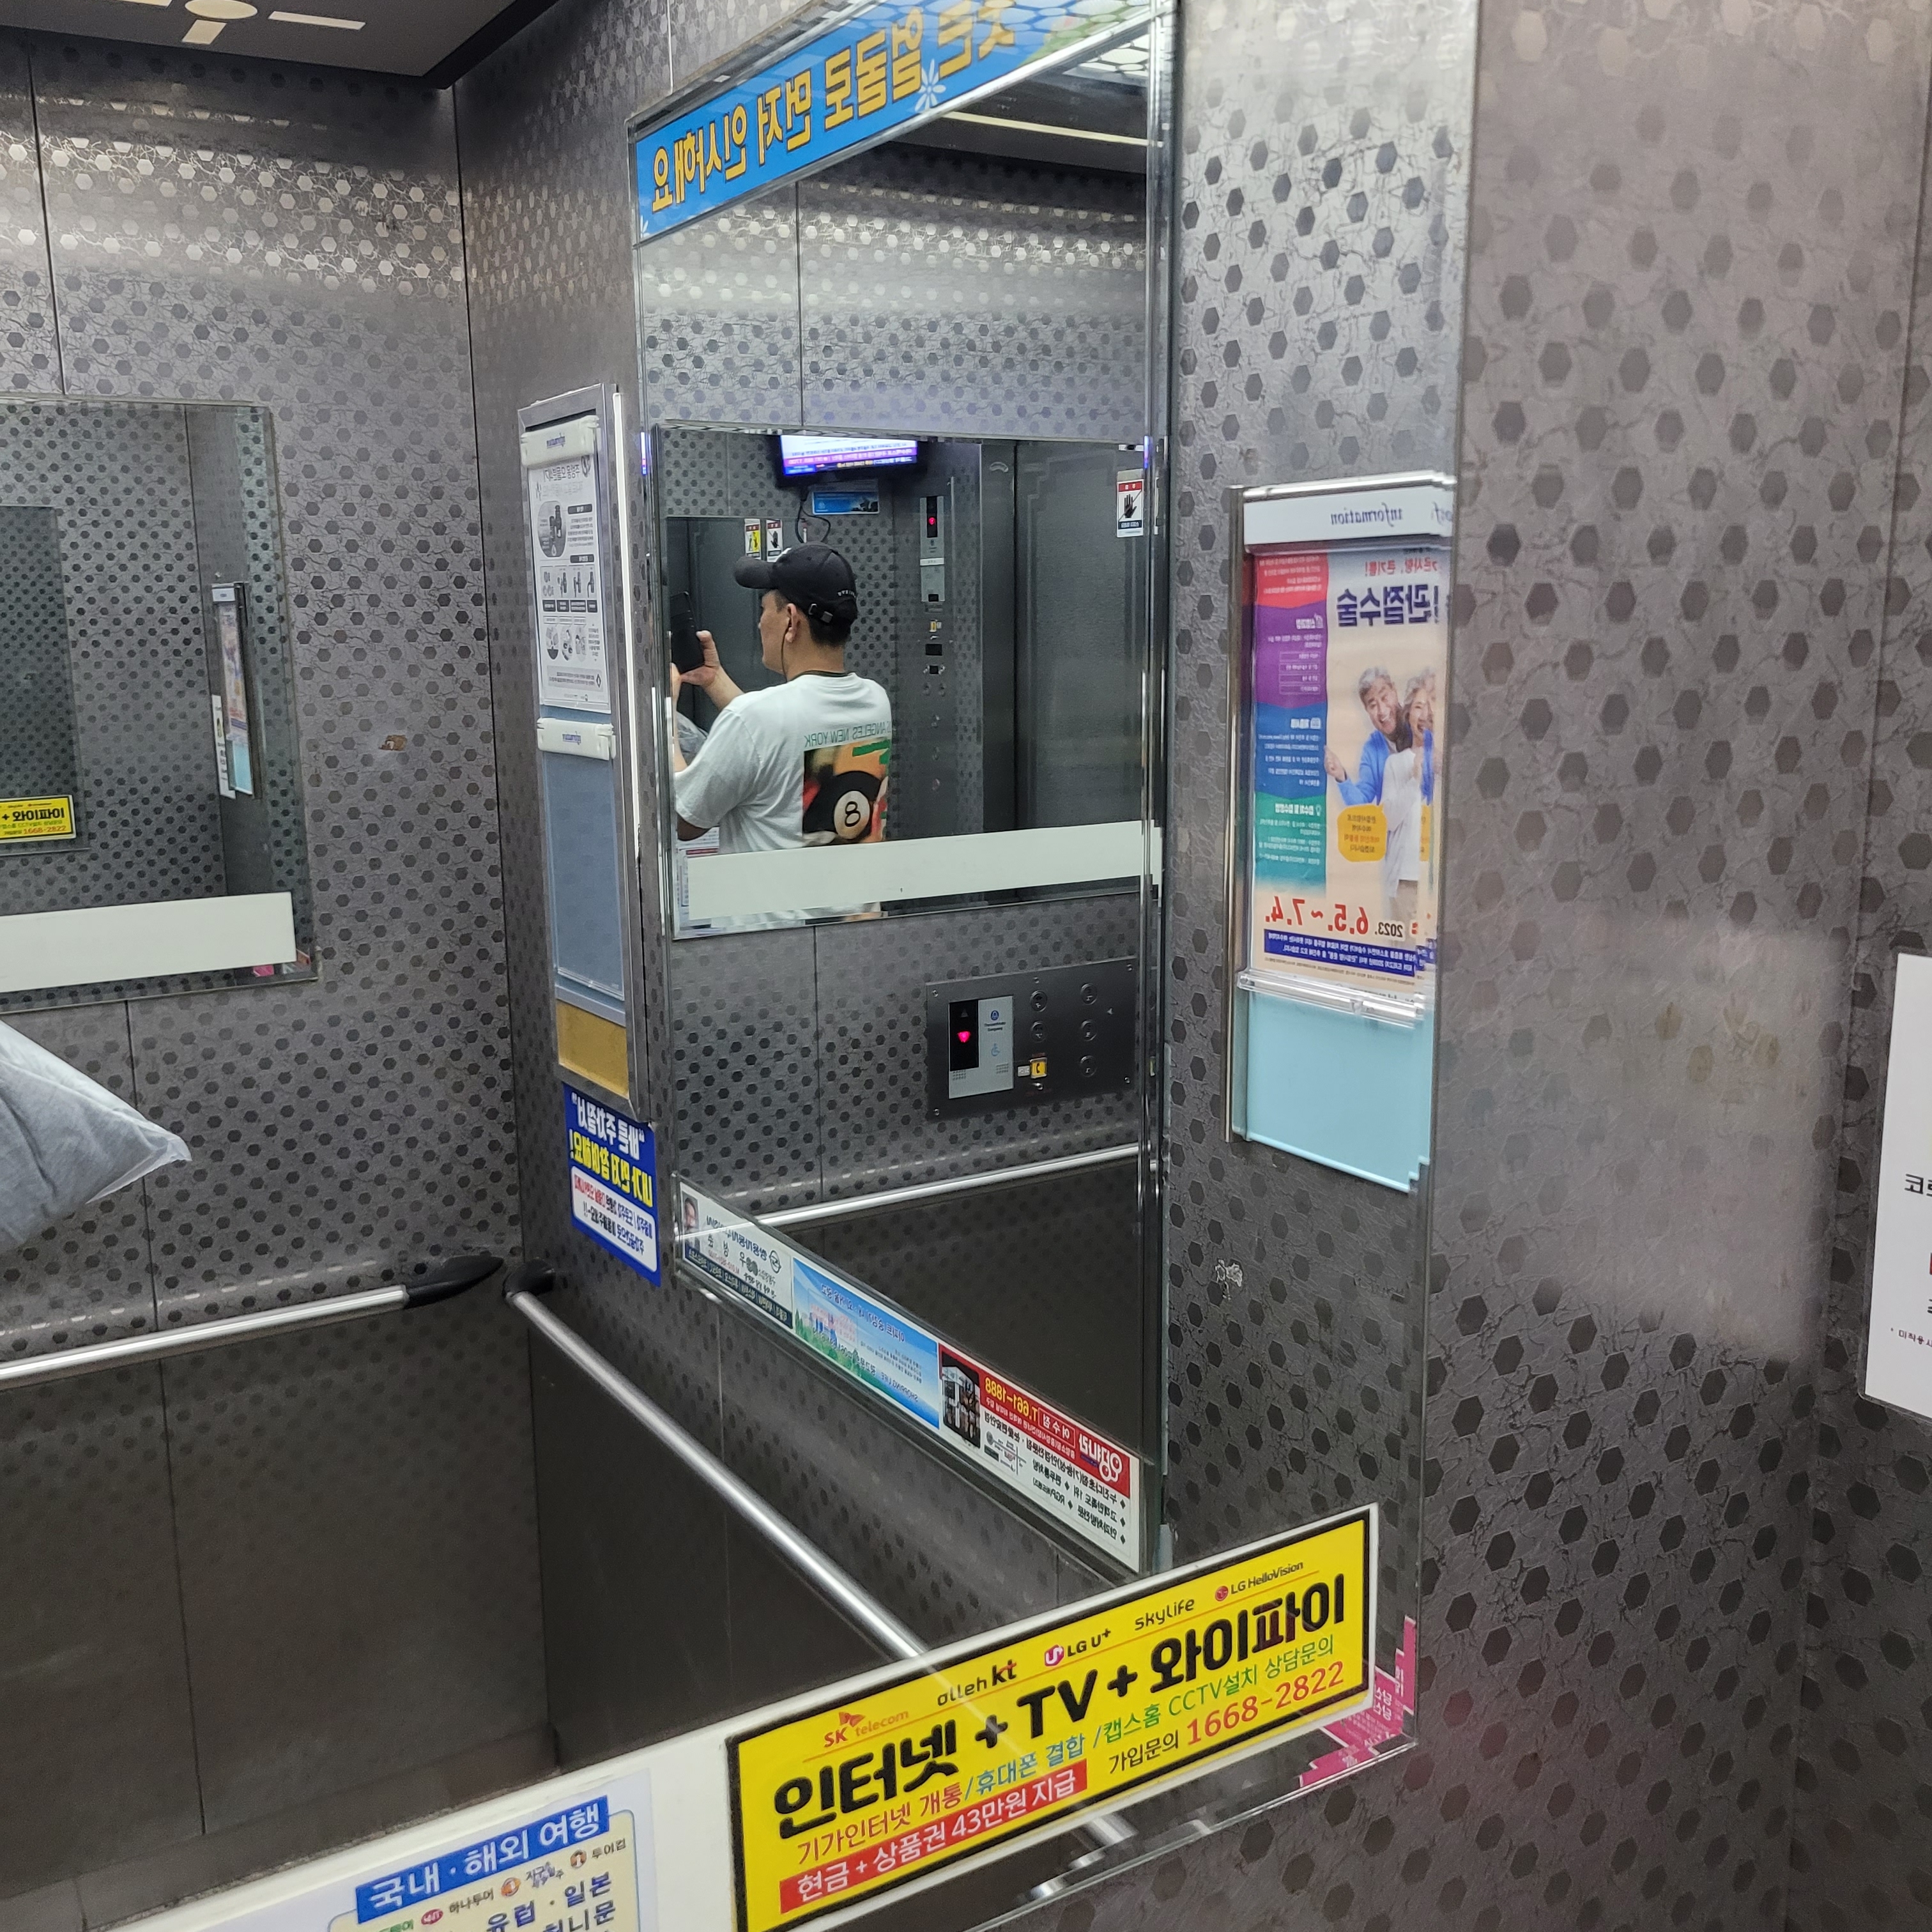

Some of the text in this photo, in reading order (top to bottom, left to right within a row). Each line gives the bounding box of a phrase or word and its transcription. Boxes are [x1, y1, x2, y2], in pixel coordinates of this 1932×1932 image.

[12, 807, 65, 822] 와이파이
[1230, 1561, 1303, 1595] LG HelloVision
[1067, 1628, 1111, 1657] LG U+
[774, 1719, 959, 1839] 인터넷
[976, 1713, 1008, 1750] +
[1018, 1667, 1099, 1738] TV
[1107, 1671, 1137, 1698] +
[1151, 1574, 1344, 1694] 와이파이
[937, 1659, 1016, 1706] olleh kt
[824, 1711, 909, 1747] SK telecom
[1109, 1734, 1181, 1774] 가입문의
[1187, 1662, 1345, 1745] 1668-2822
[798, 1797, 912, 1865] 기가인터넷
[1044, 1733, 1085, 1768] 결합
[1167, 1666, 1259, 1717] CCTV설치
[1266, 1634, 1335, 1680] 상담문의
[369, 1862, 441, 1909] 국내
[464, 1831, 528, 1876] 해외
[539, 1802, 600, 1846] 여행
[797, 1867, 847, 1903] 현금
[873, 1828, 947, 1875] 상품권
[951, 1792, 1028, 1839] 43만원
[1032, 1772, 1076, 1813] 지급
[448, 1888, 494, 1913] 하나투어
[486, 1900, 536, 1932] 유럽
[564, 1871, 612, 1908] 일본
